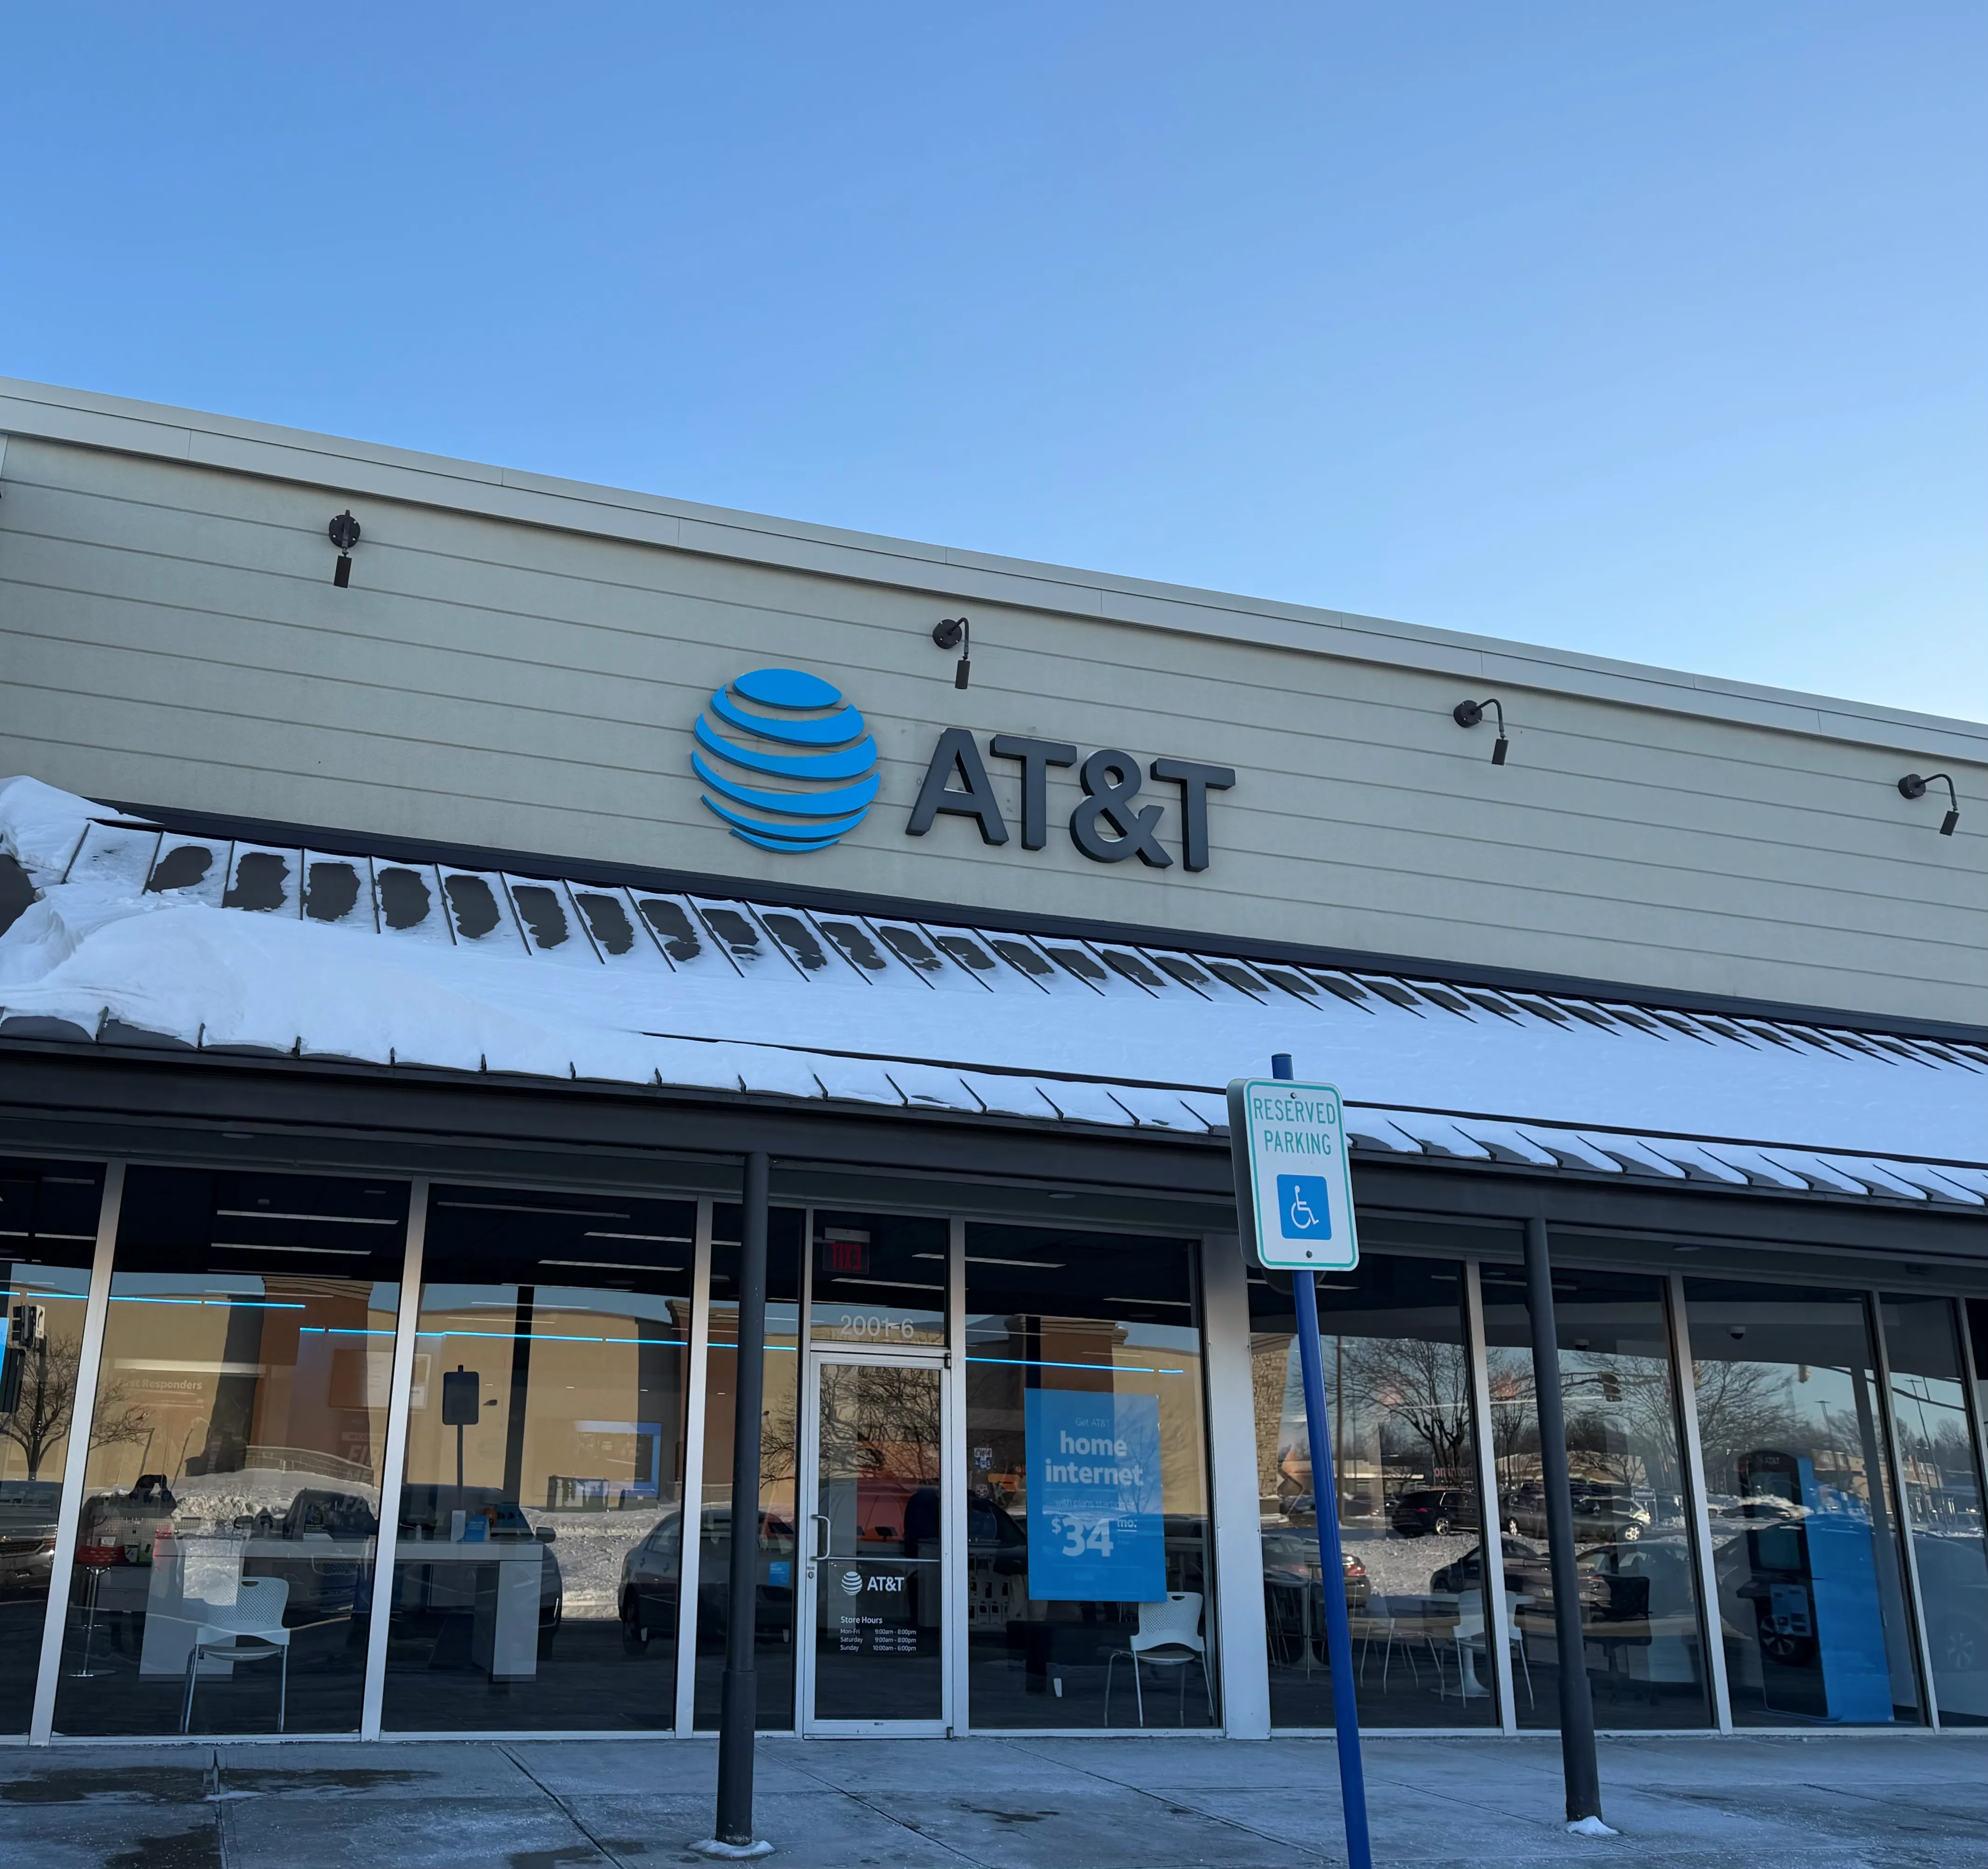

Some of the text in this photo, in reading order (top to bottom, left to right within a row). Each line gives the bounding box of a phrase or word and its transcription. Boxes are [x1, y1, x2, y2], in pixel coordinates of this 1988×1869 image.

[906, 727, 1236, 872] AT&T
[1254, 1098, 1336, 1125] RESERVED
[1264, 1130, 1331, 1155] PARKING
[840, 1314, 914, 1339] 2001-6
[142, 1379, 203, 1390] Responders
[1091, 1418, 1110, 1428] AT&T
[1060, 1430, 1128, 1456] home
[1045, 1458, 1144, 1486] internet
[1055, 1498, 1072, 1507] with
[1074, 1499, 1094, 1508] plans
[1052, 1516, 1114, 1557] $34
[867, 1576, 905, 1591] AT&T
